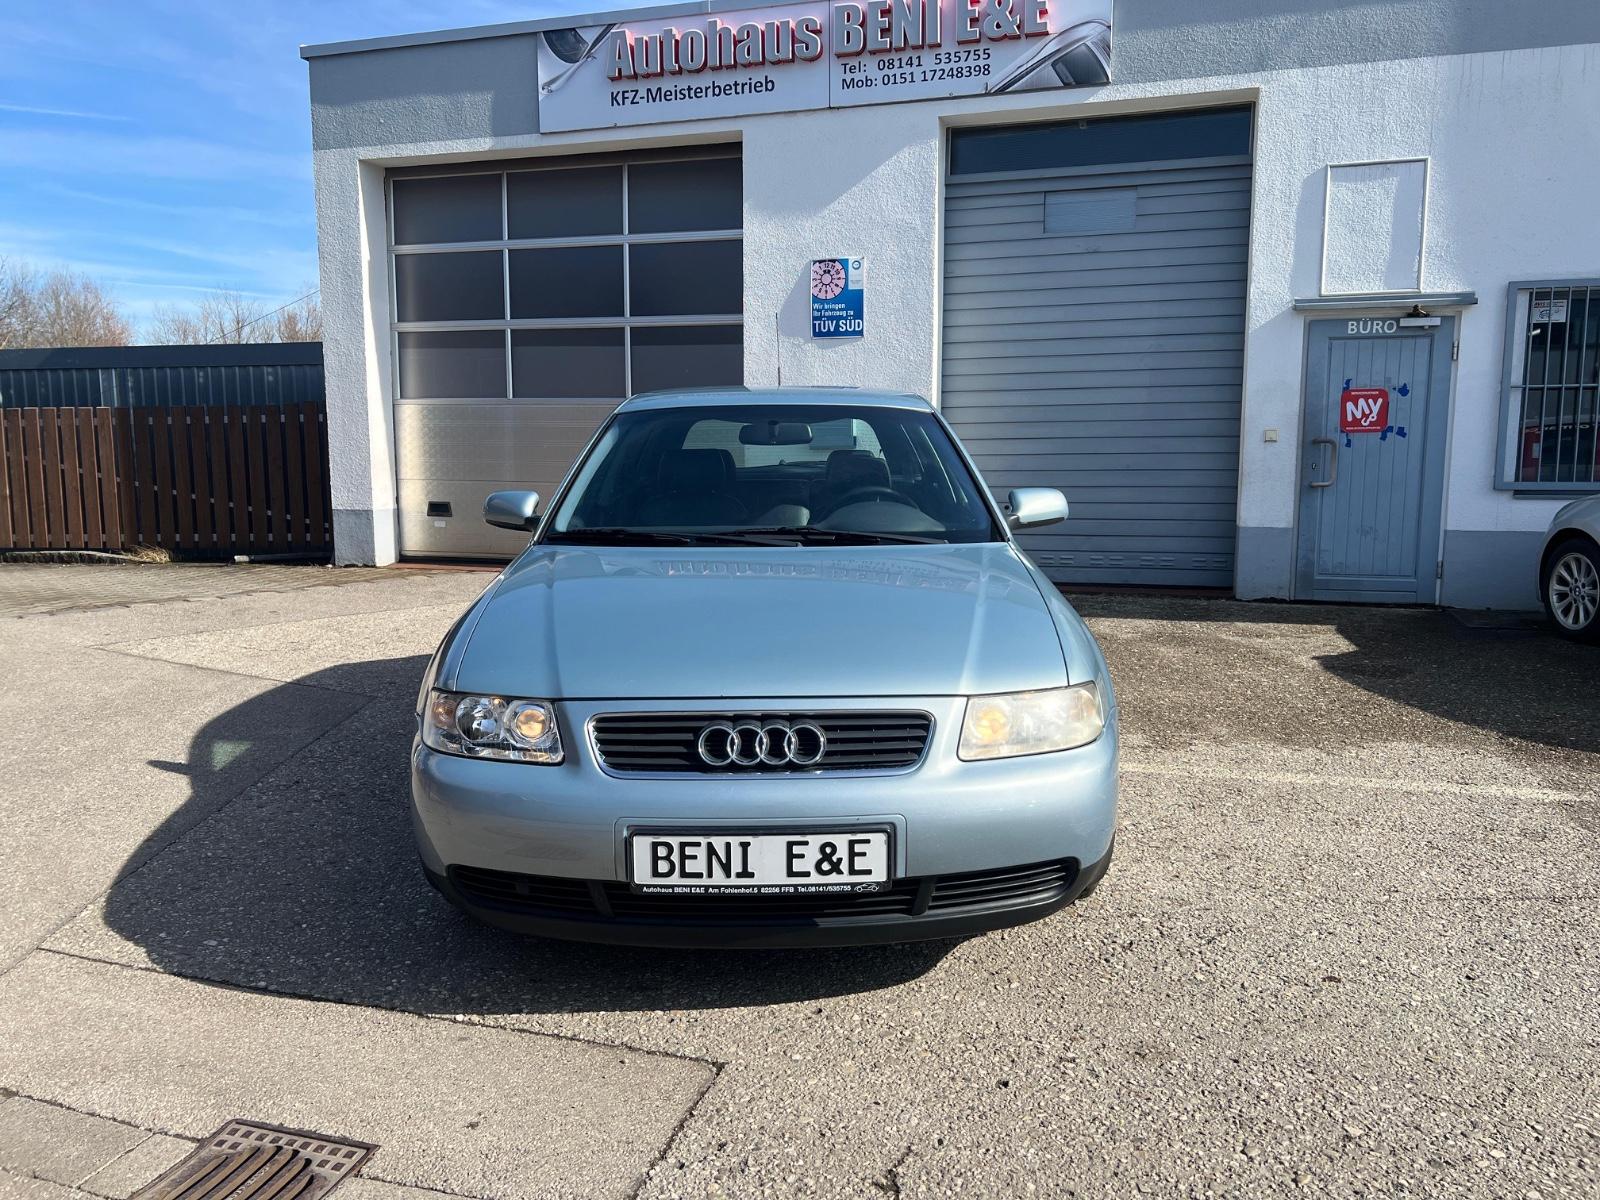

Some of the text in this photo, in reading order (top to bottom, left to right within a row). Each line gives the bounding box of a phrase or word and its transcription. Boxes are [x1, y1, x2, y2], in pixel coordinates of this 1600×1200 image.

[607, 0, 1049, 80] Autohaus BENI E&E
[841, 48, 991, 75] Tel: 08141 535755
[841, 63, 991, 90] Mob: 0151 17248398
[610, 75, 775, 107] KFZ-Meisterbetrieb
[813, 316, 863, 333] TÜV SÜD
[1347, 317, 1398, 335] BÜRO
[652, 838, 873, 879] BENI E&E
